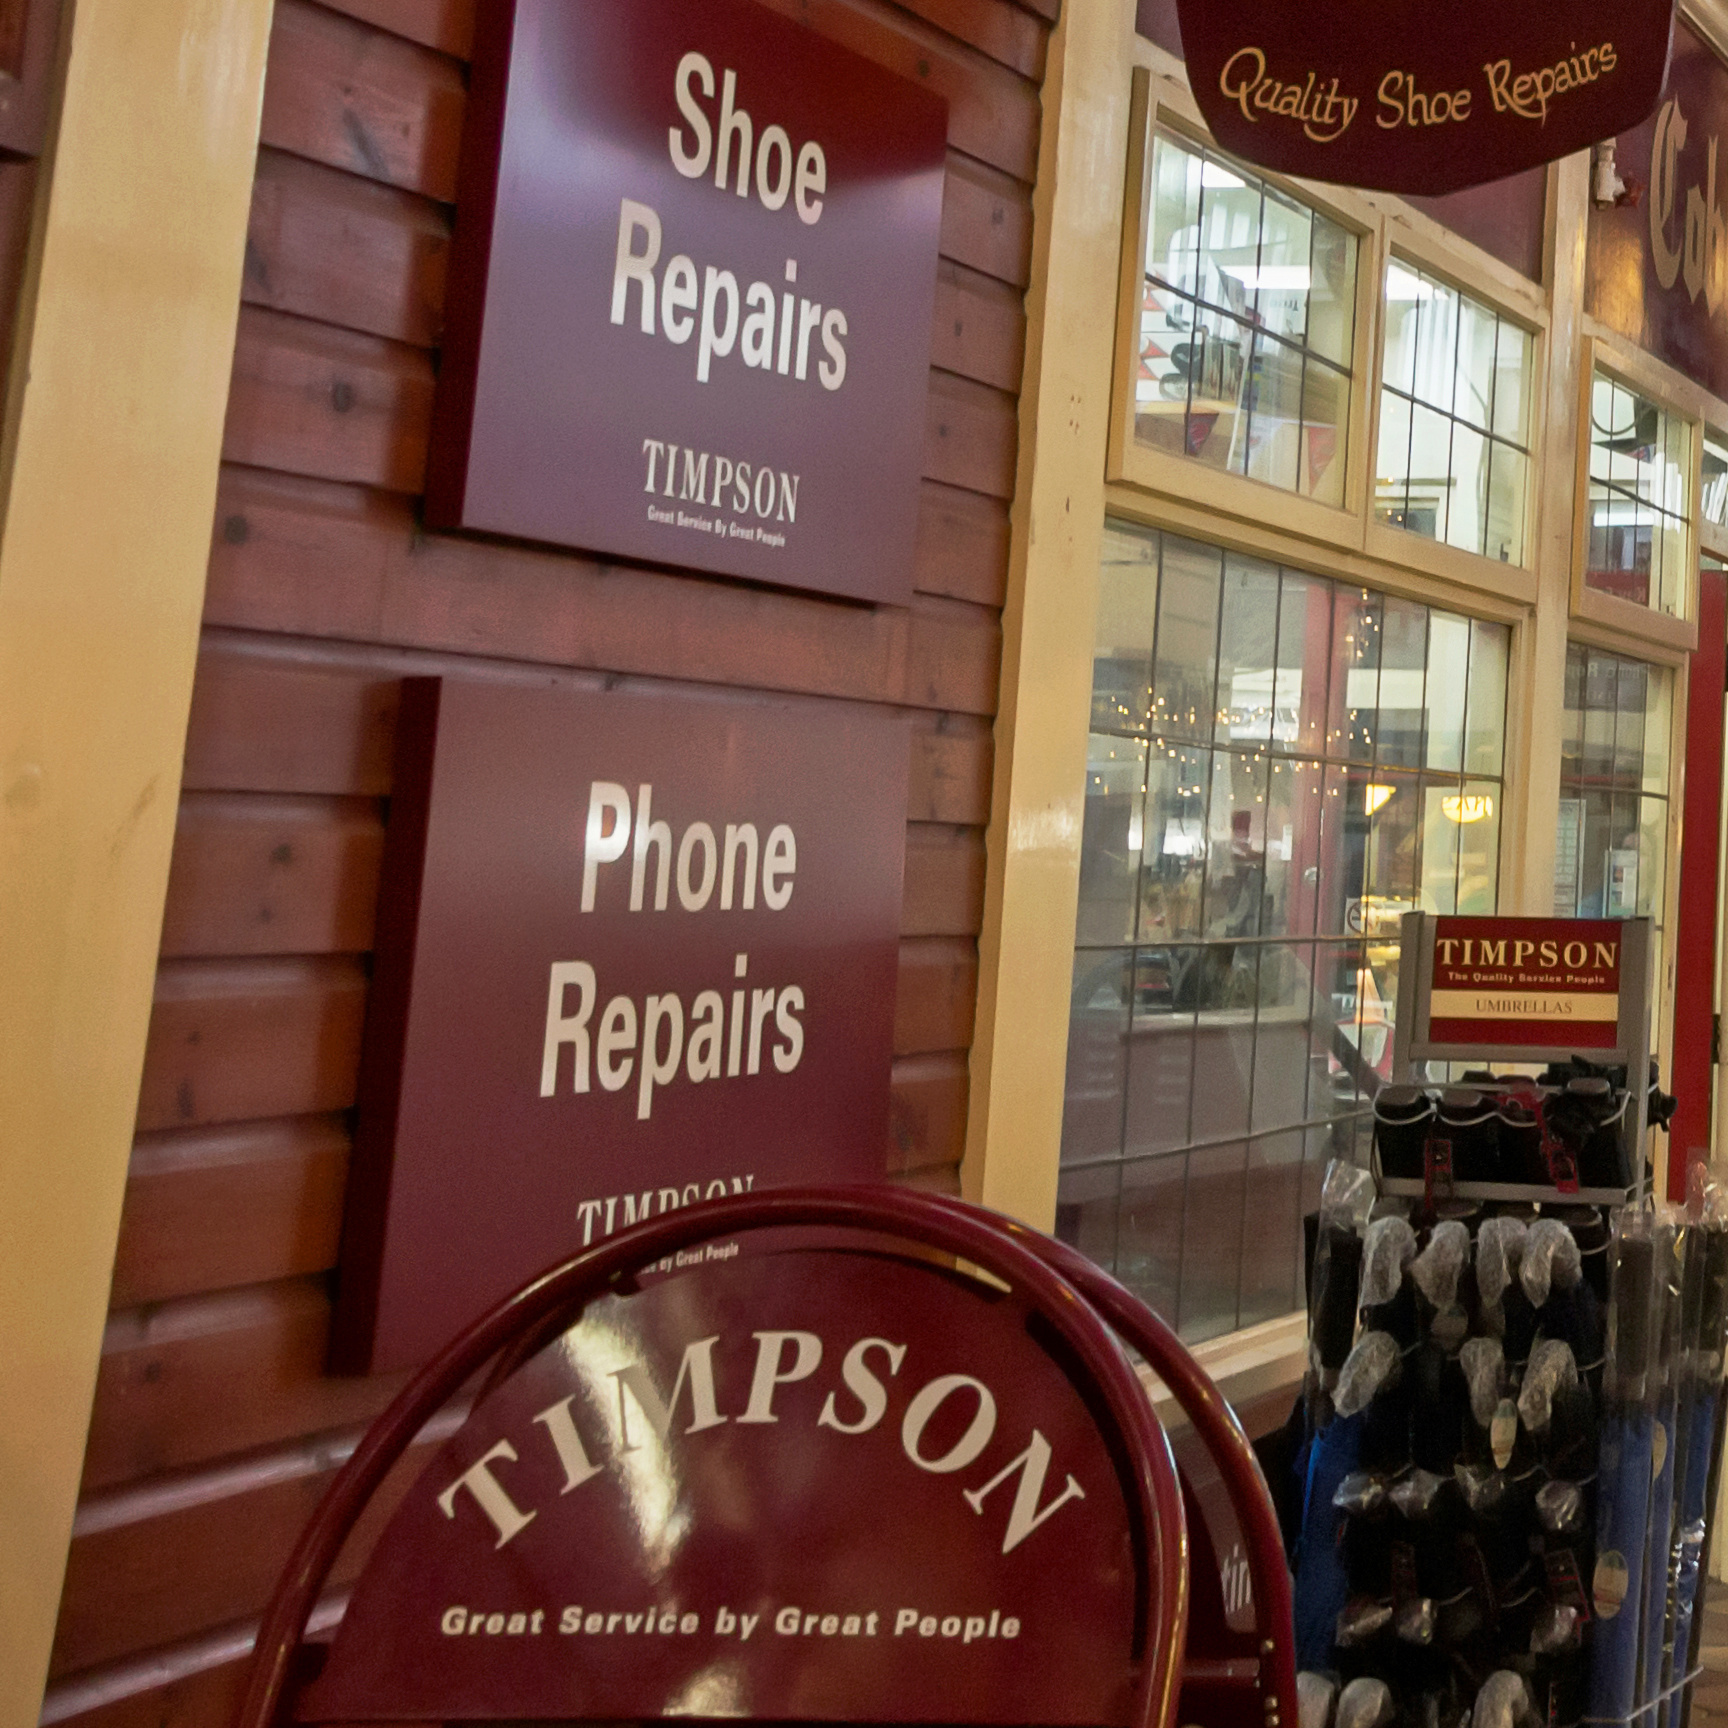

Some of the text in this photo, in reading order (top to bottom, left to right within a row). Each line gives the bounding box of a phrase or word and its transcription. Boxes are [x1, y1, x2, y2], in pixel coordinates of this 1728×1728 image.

[668, 50, 828, 226] Shoe
[1219, 40, 1617, 144] Quality Shoe Repairs
[609, 197, 848, 392] Repairs
[642, 438, 800, 523] TIMPSON
[647, 504, 675, 524] Great
[729, 521, 754, 541] Great
[580, 780, 798, 913] Phone
[1436, 937, 1618, 970] TIMPSON
[540, 953, 805, 1120] Repairs
[1475, 999, 1573, 1014] UMBRELLAS
[675, 1249, 704, 1268] Great
[705, 1241, 740, 1262] People
[436, 1327, 1086, 1556] TIMPSON
[440, 1605, 1021, 1644] Great Service by Great People
